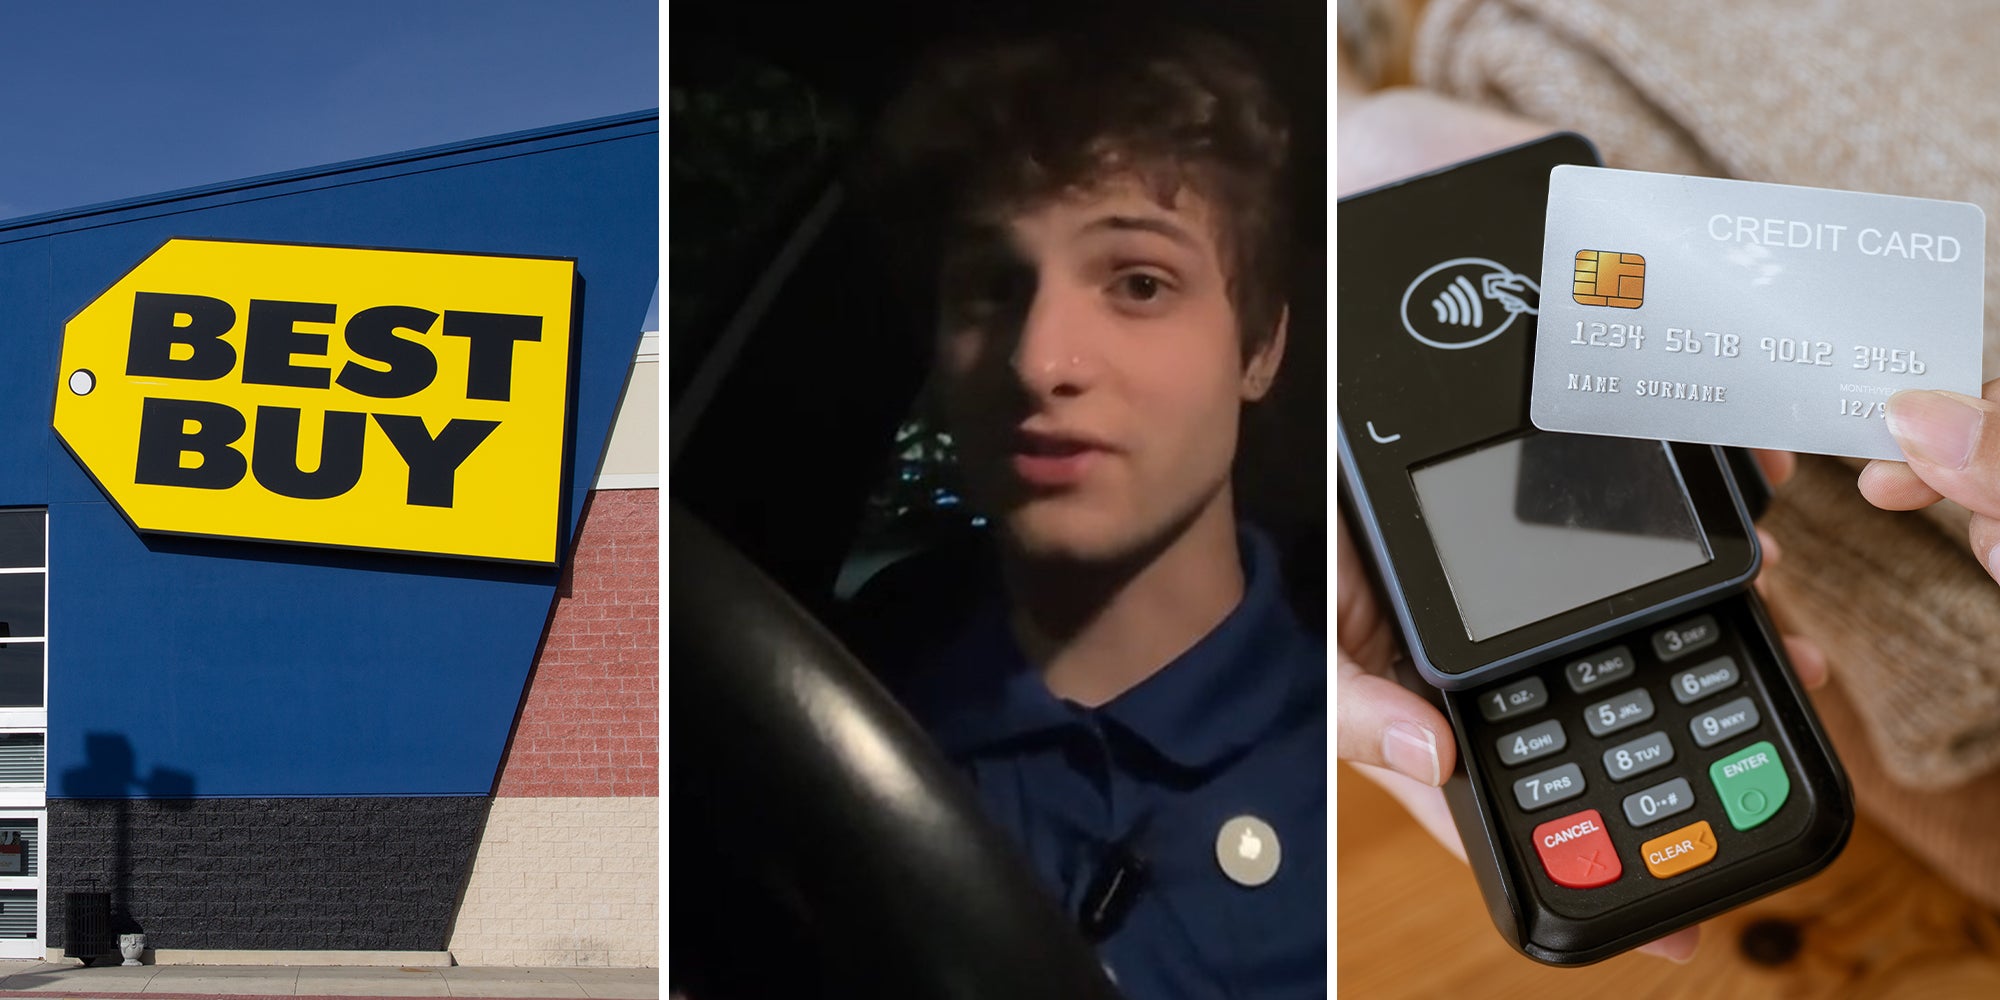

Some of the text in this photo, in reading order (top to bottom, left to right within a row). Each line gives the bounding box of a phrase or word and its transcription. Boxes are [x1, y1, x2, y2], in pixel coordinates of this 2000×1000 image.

[1707, 214, 1961, 263] CREDIT CARD
[126, 291, 543, 402] BEST
[1570, 320, 1926, 375] 1234 5678 9012 3456
[1567, 373, 1727, 403] NAME SURNAME
[1840, 383, 1898, 396] MONTH/YEA
[1840, 399, 1887, 420] 12/9
[134, 396, 503, 509] BUY
[1664, 630, 1683, 651] 3
[1577, 657, 1624, 684] 2 ABC
[1681, 668, 1730, 695] 6 MNO
[1493, 692, 1507, 713] 1
[1598, 701, 1642, 726] 5 JKL
[1702, 711, 1746, 736] 9 WXY
[1512, 734, 1553, 756] 4 GHI
[1615, 744, 1661, 771] 8 TUV
[1723, 752, 1769, 778] ENTER
[1525, 776, 1572, 801] 7 PRS
[1640, 794, 1657, 816] 0
[1544, 819, 1600, 848] CANCEL
[1649, 839, 1694, 865] CLEAR
